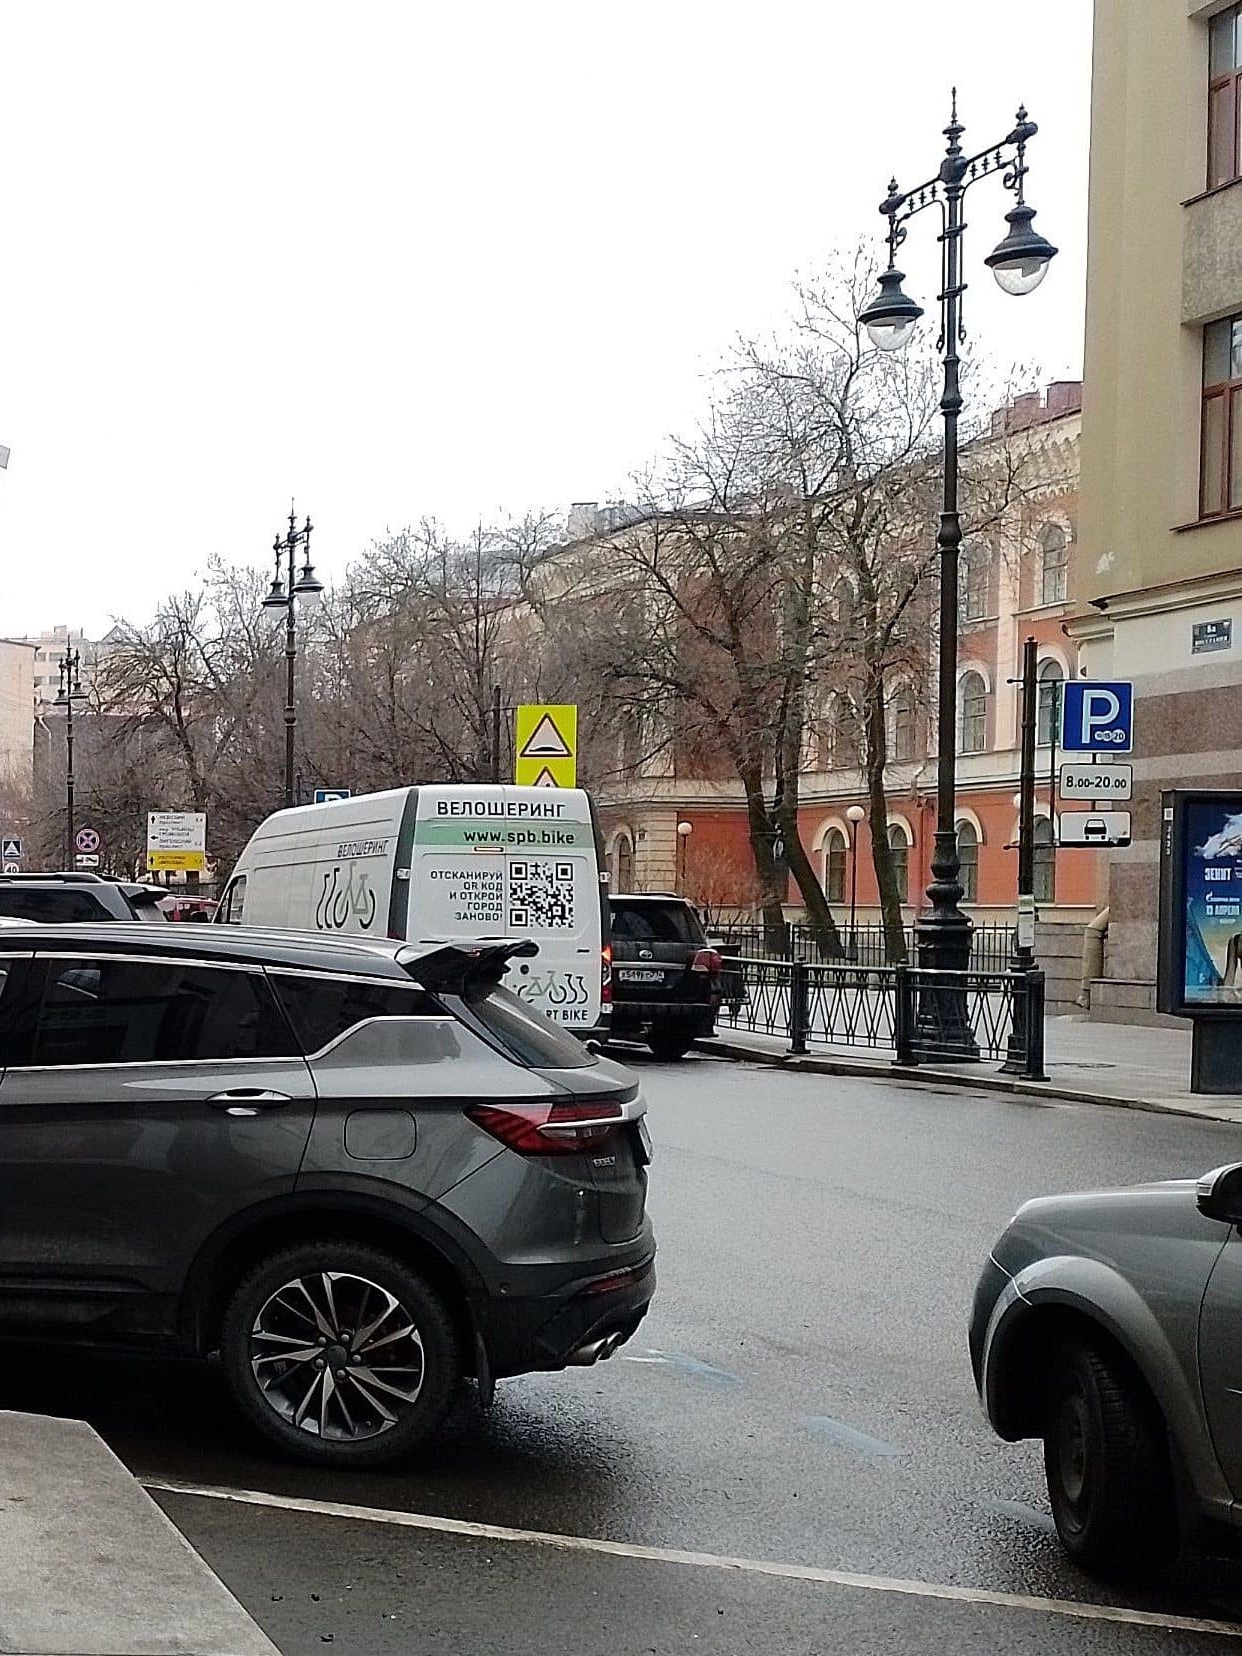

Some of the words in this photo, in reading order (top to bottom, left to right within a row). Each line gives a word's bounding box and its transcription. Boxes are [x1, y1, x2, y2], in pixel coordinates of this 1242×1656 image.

[1081, 690, 1119, 743] P
[1114, 731, 1124, 740] 20
[1066, 776, 1126, 788] 8.00-20.00
[437, 801, 566, 817] ВЕЛОШЕРИНГ
[464, 830, 574, 845] www.spb.bike
[338, 840, 389, 857] ВЕЛОШЕРИНГ
[430, 870, 503, 880] ОТСКАНИРУЙ
[463, 882, 478, 890] QR
[481, 882, 503, 891] КОД
[449, 892, 457, 900] И
[460, 891, 503, 900] ОТКРОЙ
[467, 902, 503, 912] ГОРОД
[455, 912, 502, 921] ЗАНОВО!
[562, 1009, 588, 1020] BIKE
